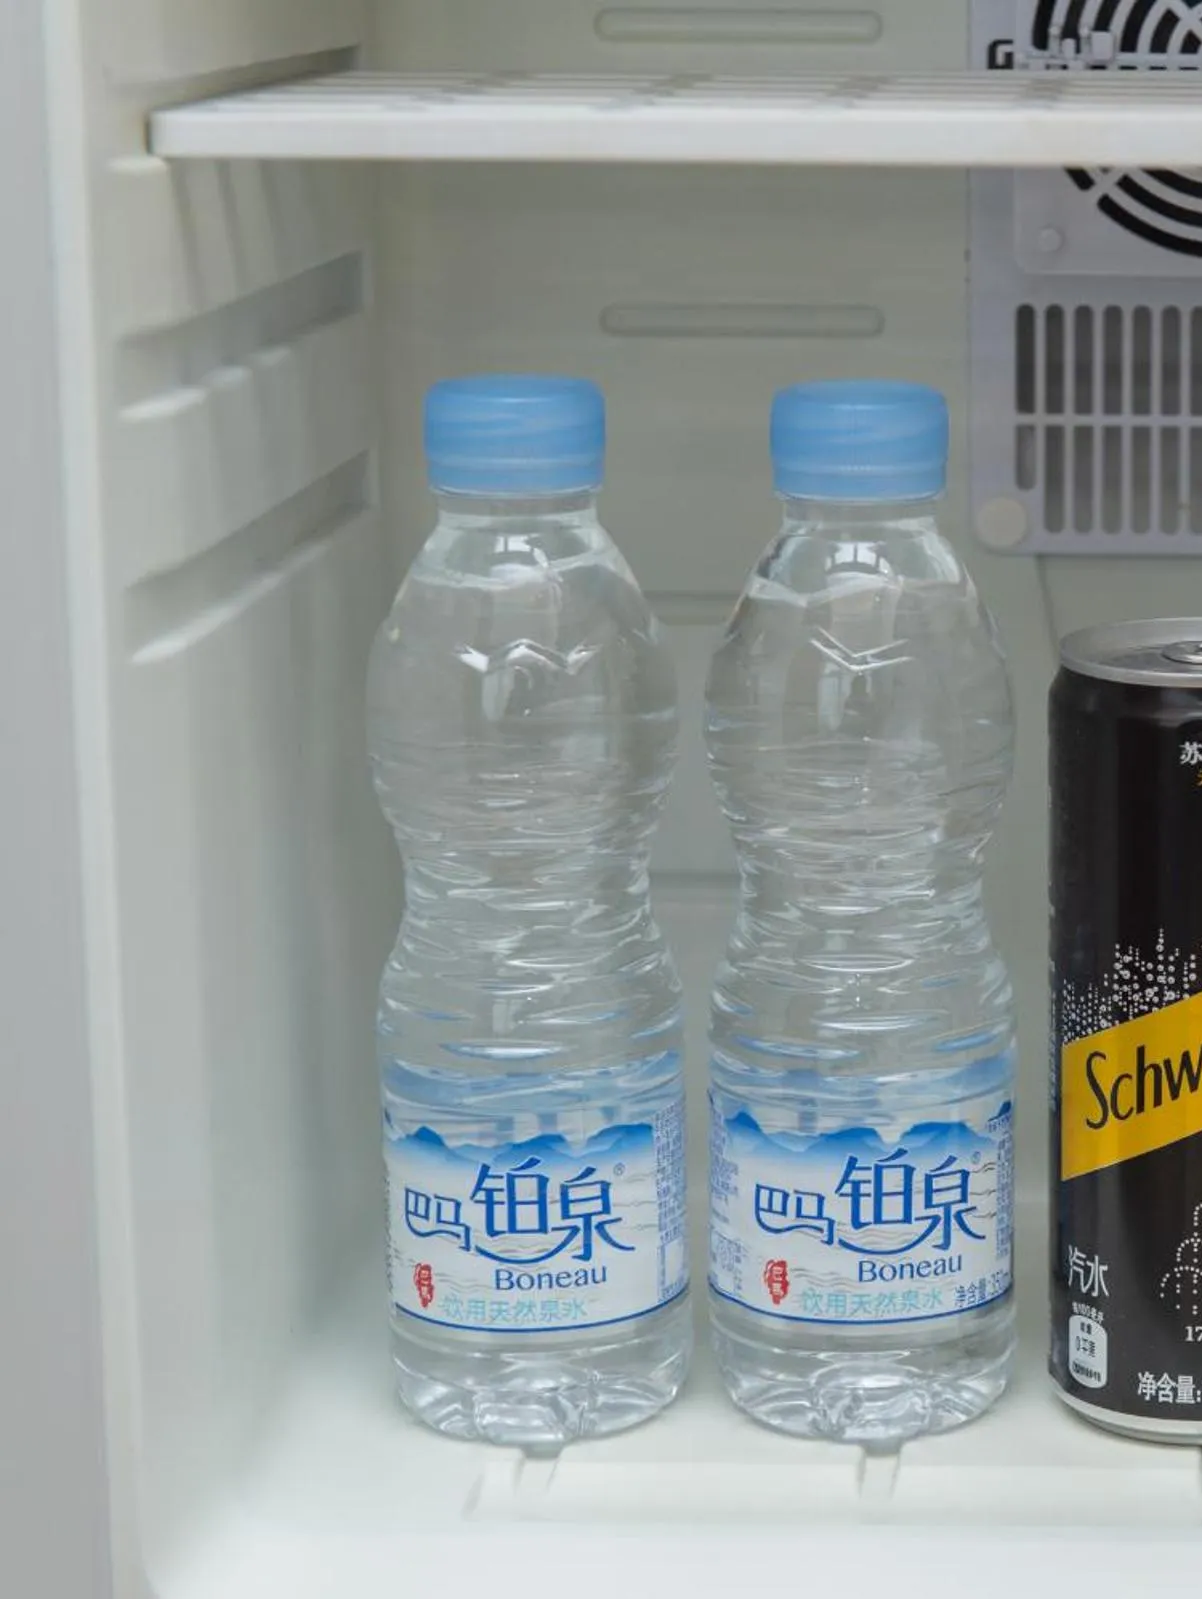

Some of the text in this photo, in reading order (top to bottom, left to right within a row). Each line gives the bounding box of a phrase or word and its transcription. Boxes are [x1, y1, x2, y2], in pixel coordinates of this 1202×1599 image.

[494, 1266, 607, 1291] Boneau
[857, 1254, 963, 1283] Boneau
[1068, 1245, 1109, 1297] 汽水
[438, 1296, 588, 1324] 饮用天然泉水
[799, 1287, 943, 1318] 饮用天然泉水
